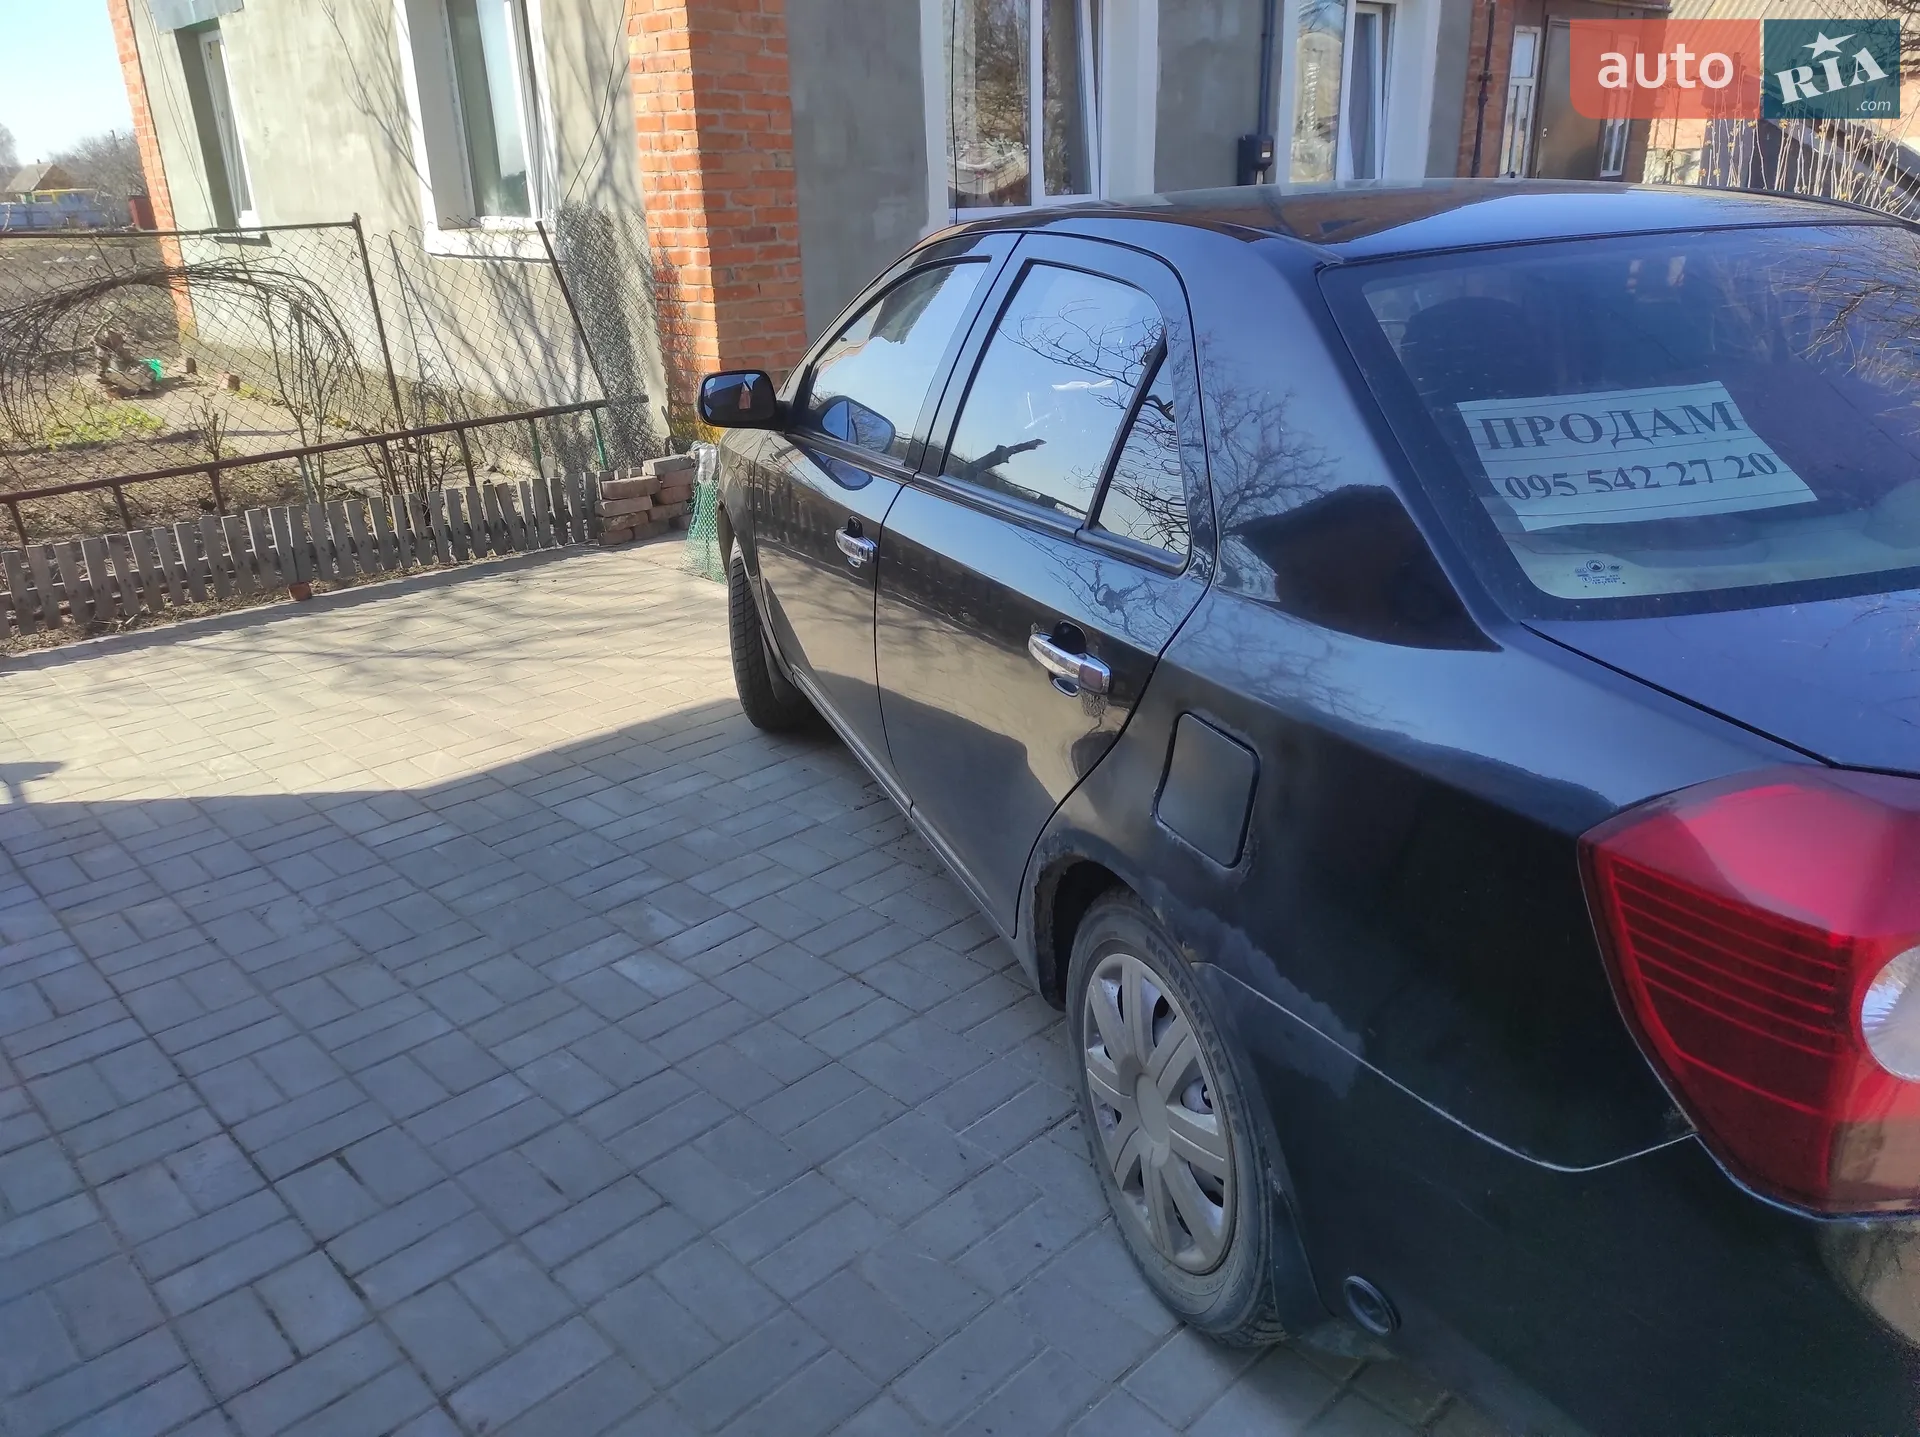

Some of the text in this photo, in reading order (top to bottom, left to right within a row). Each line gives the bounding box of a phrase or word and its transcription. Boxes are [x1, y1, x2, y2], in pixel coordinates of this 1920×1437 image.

[1478, 401, 1743, 449] ПРОДАМ
[1505, 452, 1778, 500] 095 542 27 20
